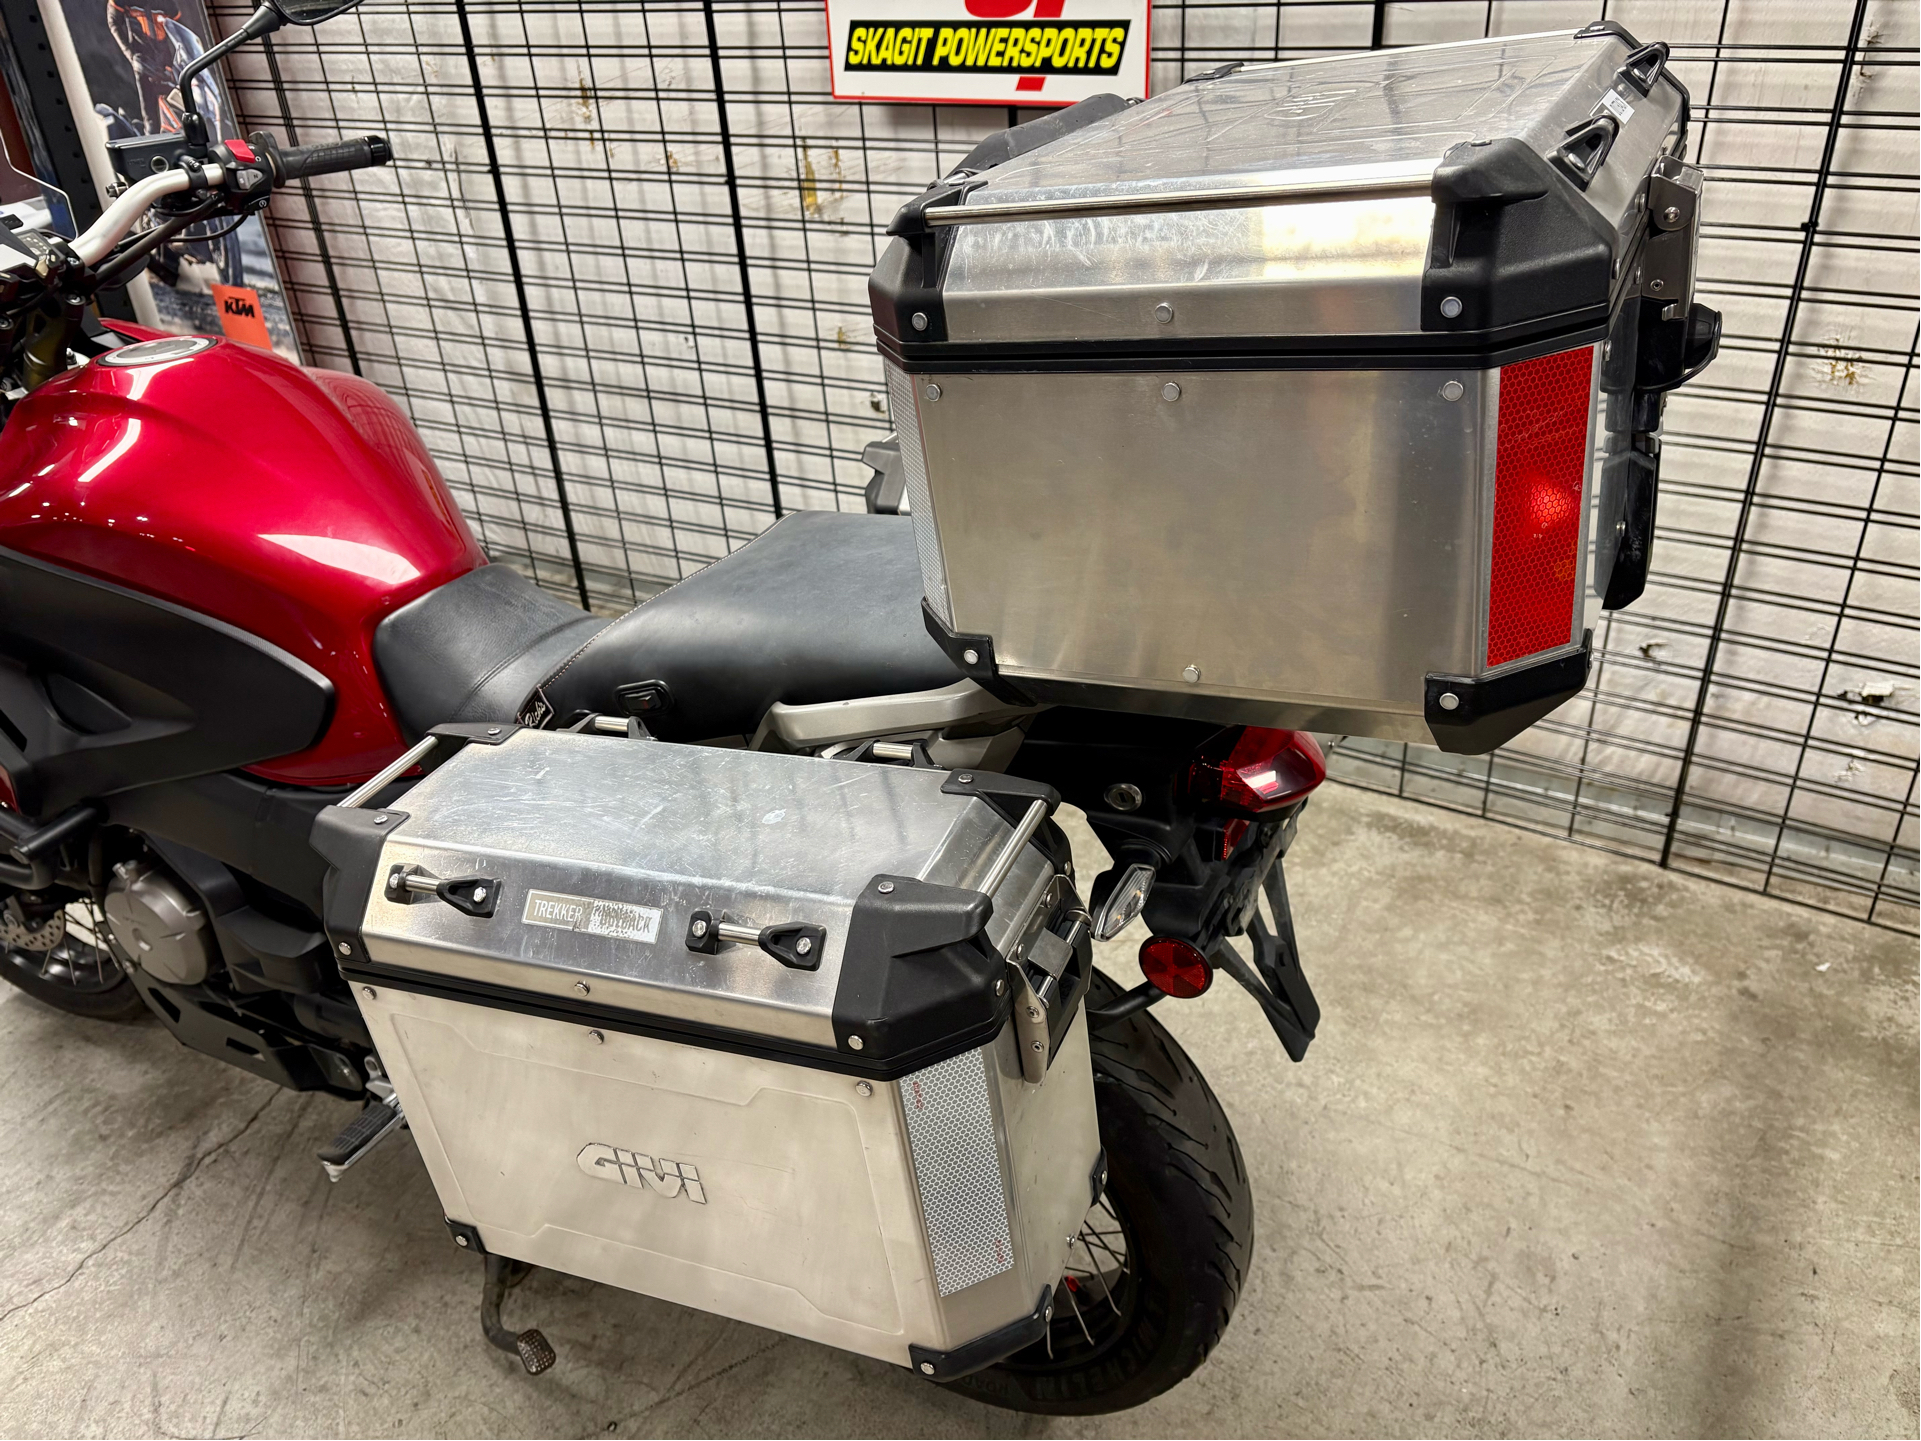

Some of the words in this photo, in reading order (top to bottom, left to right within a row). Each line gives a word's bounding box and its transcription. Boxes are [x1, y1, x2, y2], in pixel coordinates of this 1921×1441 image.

[848, 27, 933, 66] SKAGIT
[932, 27, 1125, 69] POWERSPORTS
[224, 296, 255, 318] KTM
[534, 899, 583, 922] TREKKER
[576, 1142, 707, 1205] GIVI
